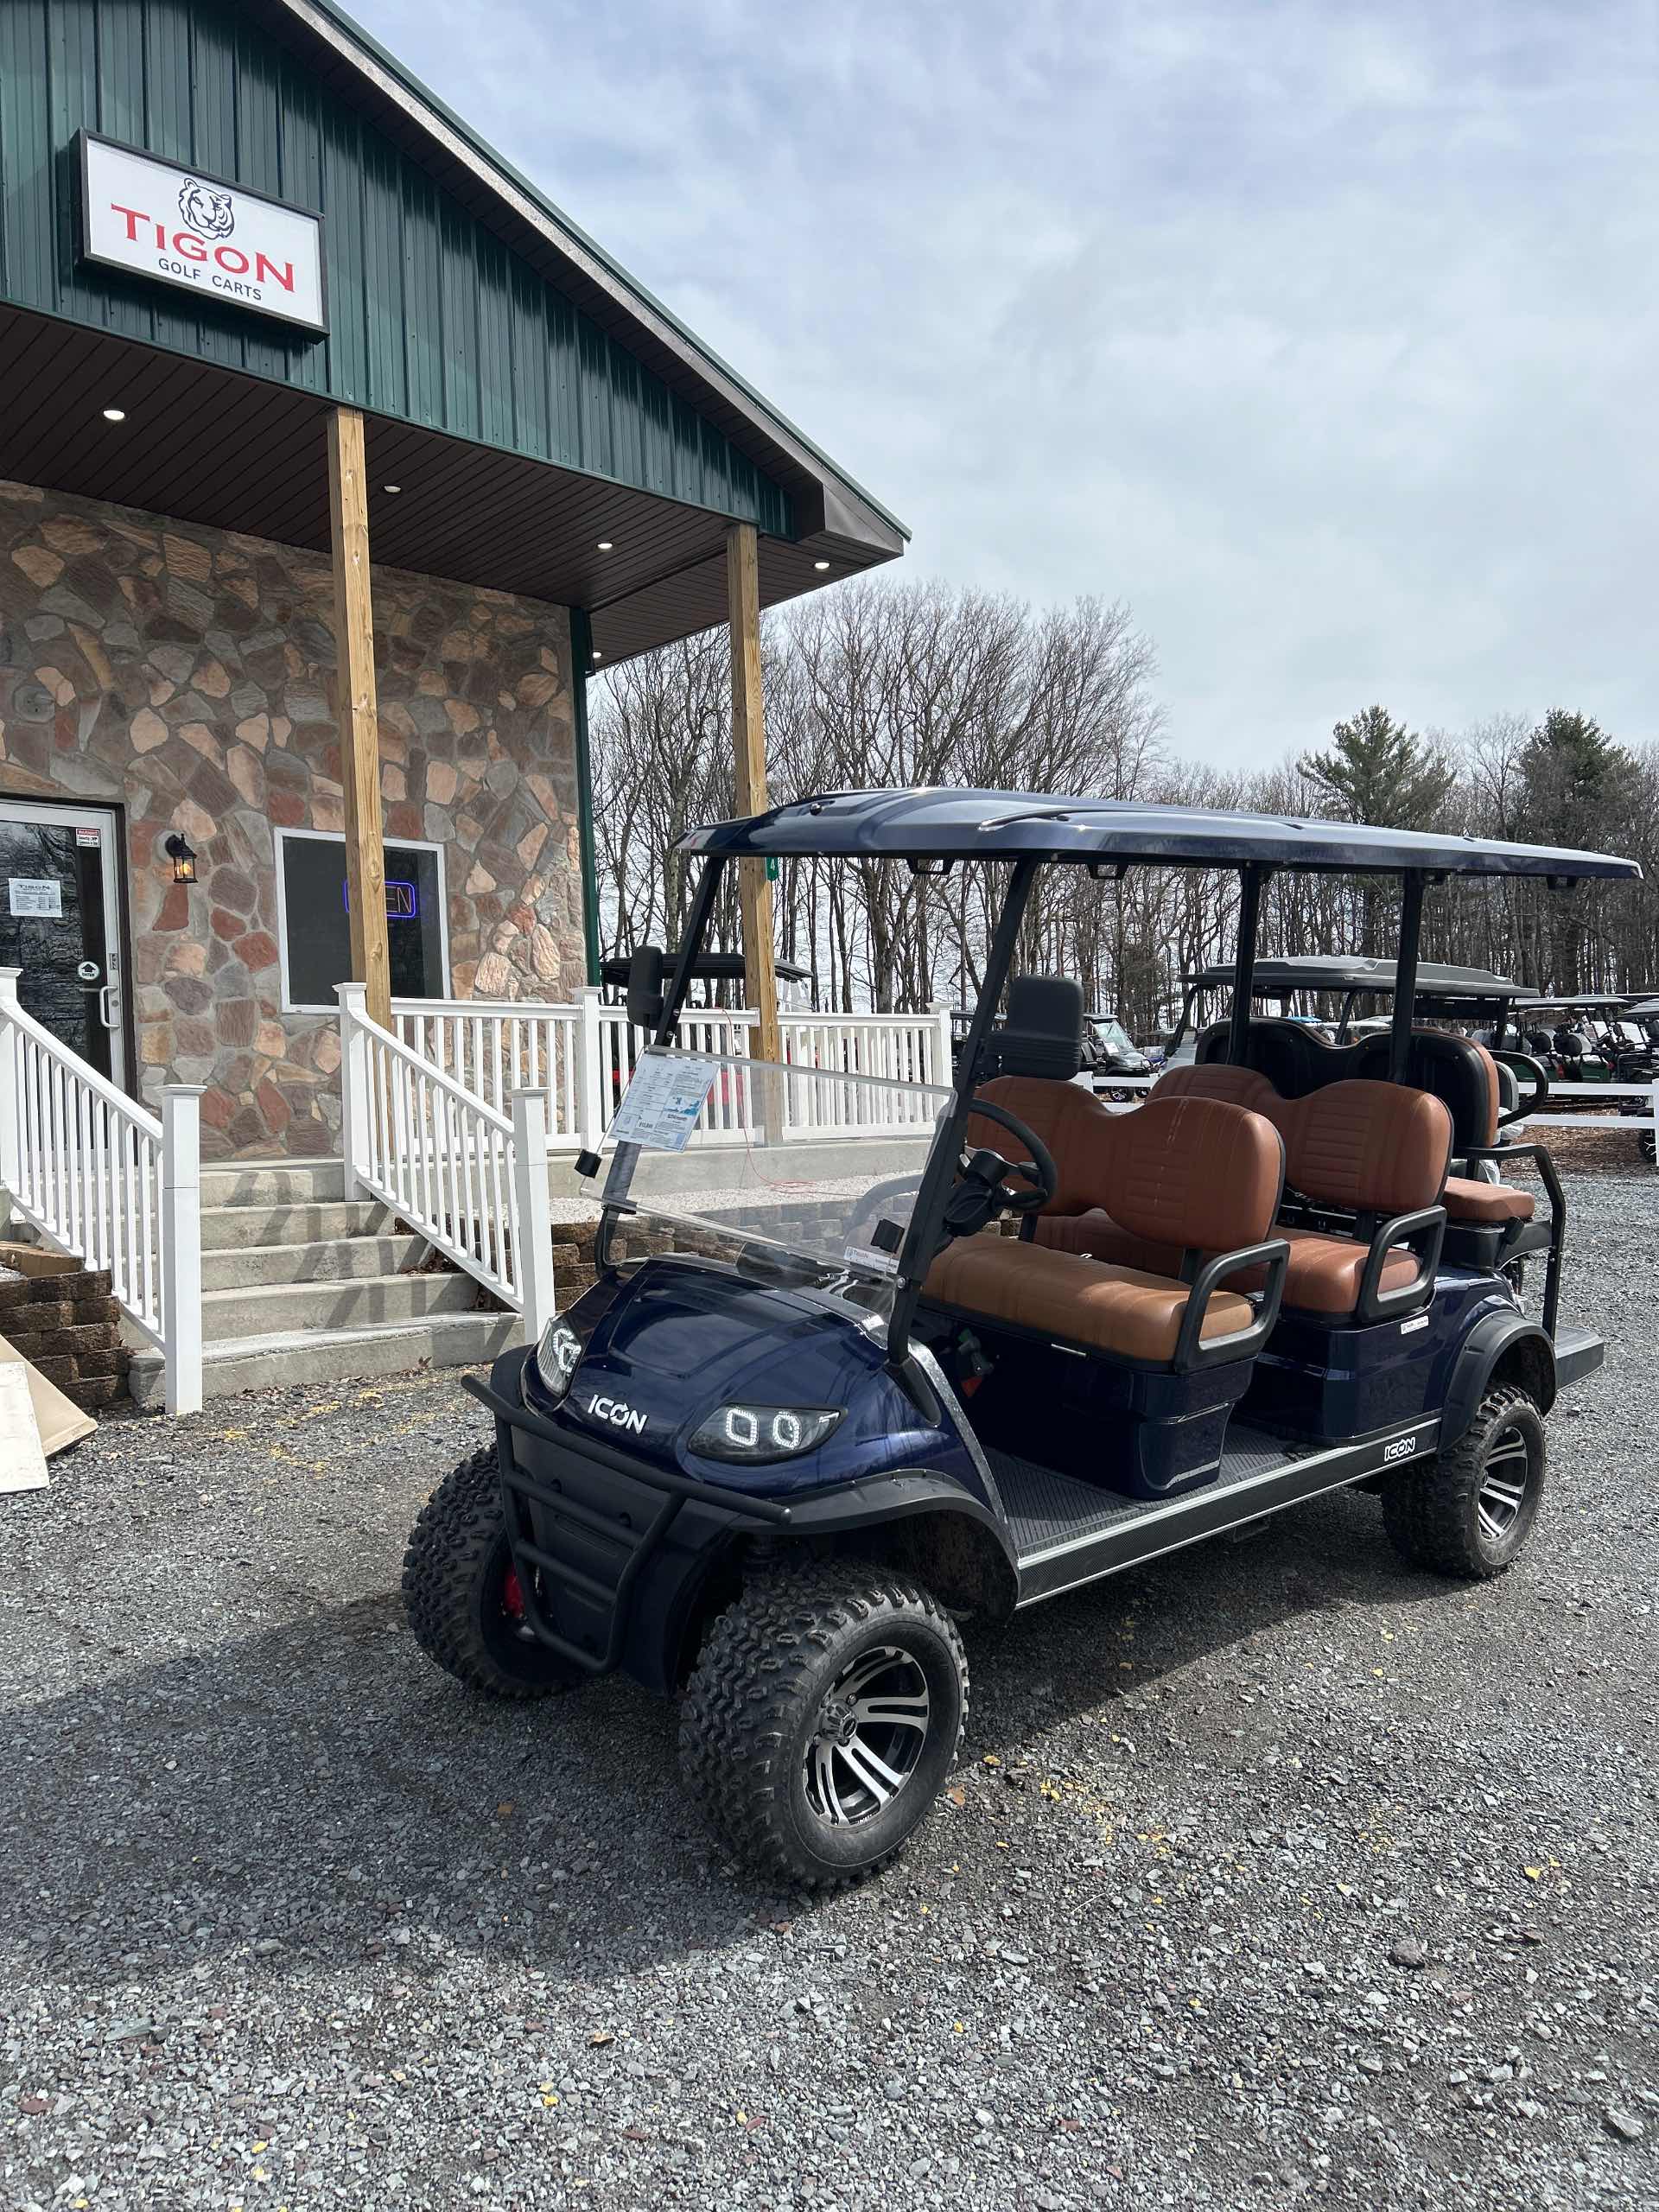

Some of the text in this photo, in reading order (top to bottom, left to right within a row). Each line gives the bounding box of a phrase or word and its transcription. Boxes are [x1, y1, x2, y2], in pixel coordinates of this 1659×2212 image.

[111, 203, 295, 293] TIGON
[158, 257, 262, 301] GOLF CARTS
[588, 1394, 647, 1434] ICON
[1384, 1437, 1415, 1461] ICON
